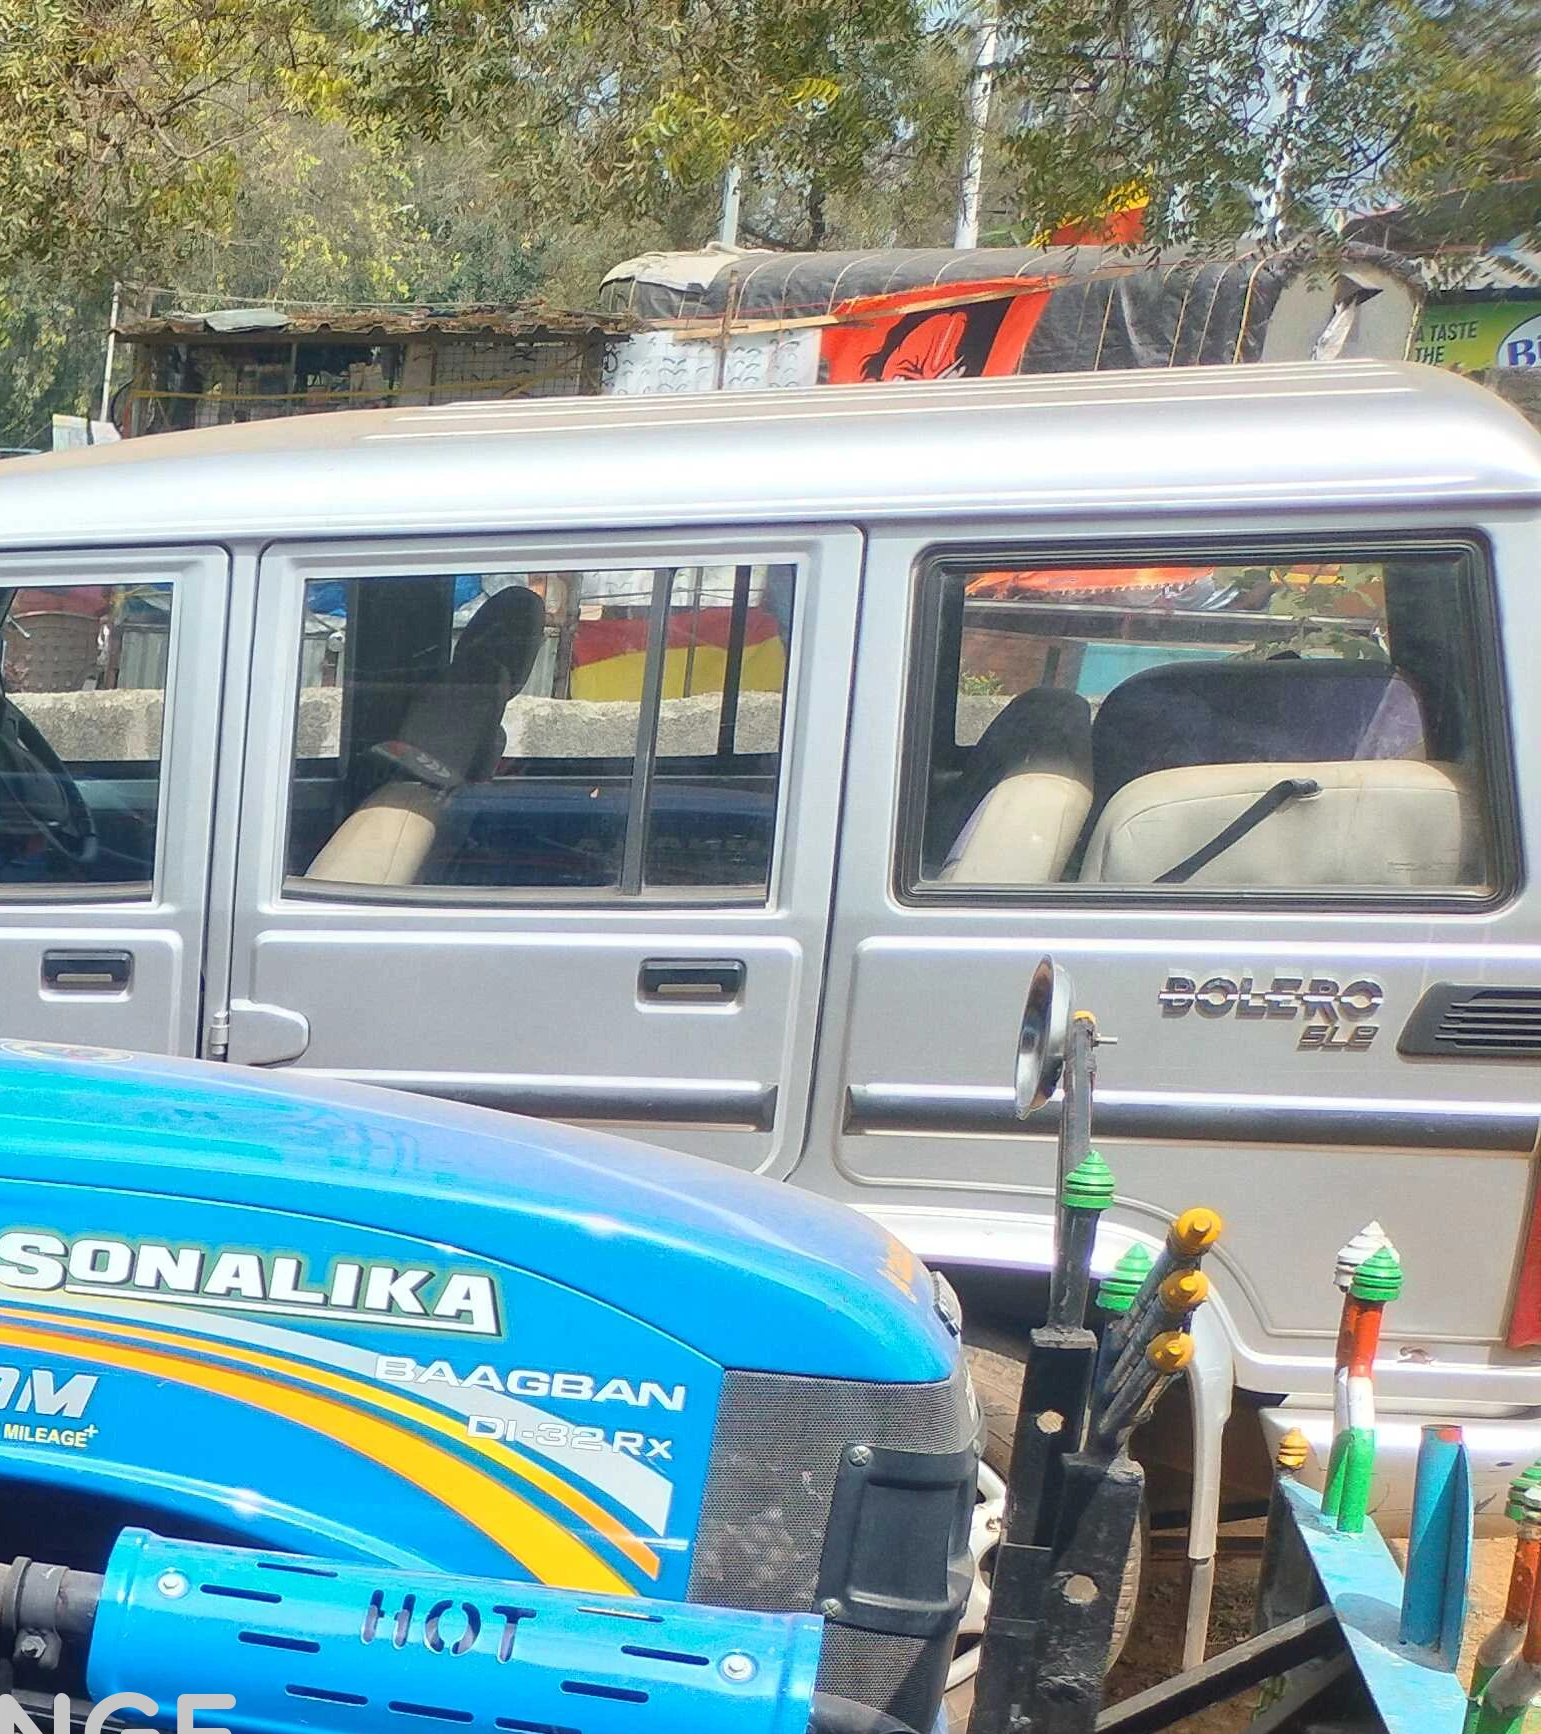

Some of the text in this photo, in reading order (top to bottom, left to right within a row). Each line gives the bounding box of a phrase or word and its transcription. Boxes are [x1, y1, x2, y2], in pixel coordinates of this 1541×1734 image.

[1415, 346, 1445, 366] THE
[1430, 320, 1479, 342] TASTE
[1157, 975, 1384, 1026] BOLERO
[375, 1354, 686, 1411] BAAGBAN
[361, 1589, 538, 1664] HOT
